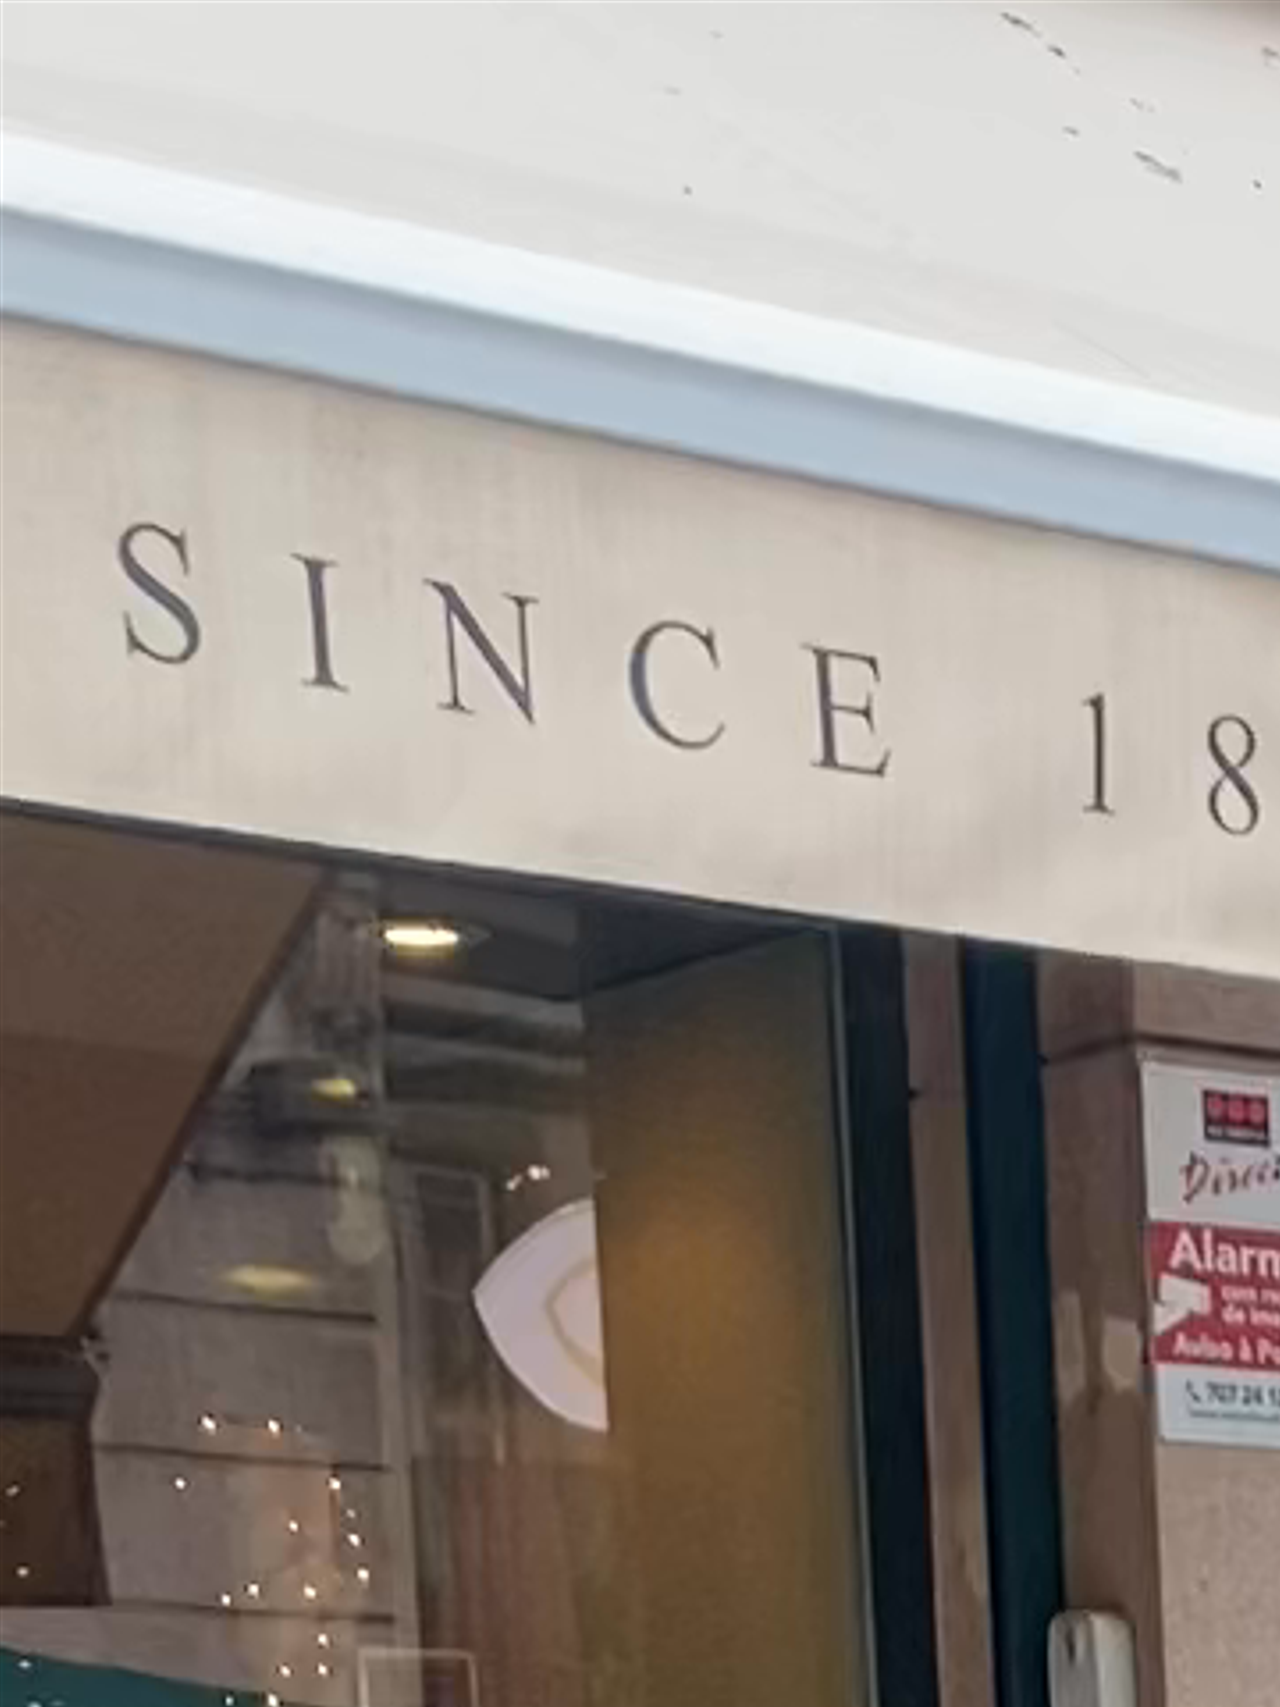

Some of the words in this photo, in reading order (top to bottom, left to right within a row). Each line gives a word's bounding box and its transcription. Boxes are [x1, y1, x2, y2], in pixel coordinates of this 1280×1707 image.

[117, 523, 893, 778] SINCE
[1222, 1304, 1245, 1323] de
[1172, 1332, 1233, 1361] Aviso
